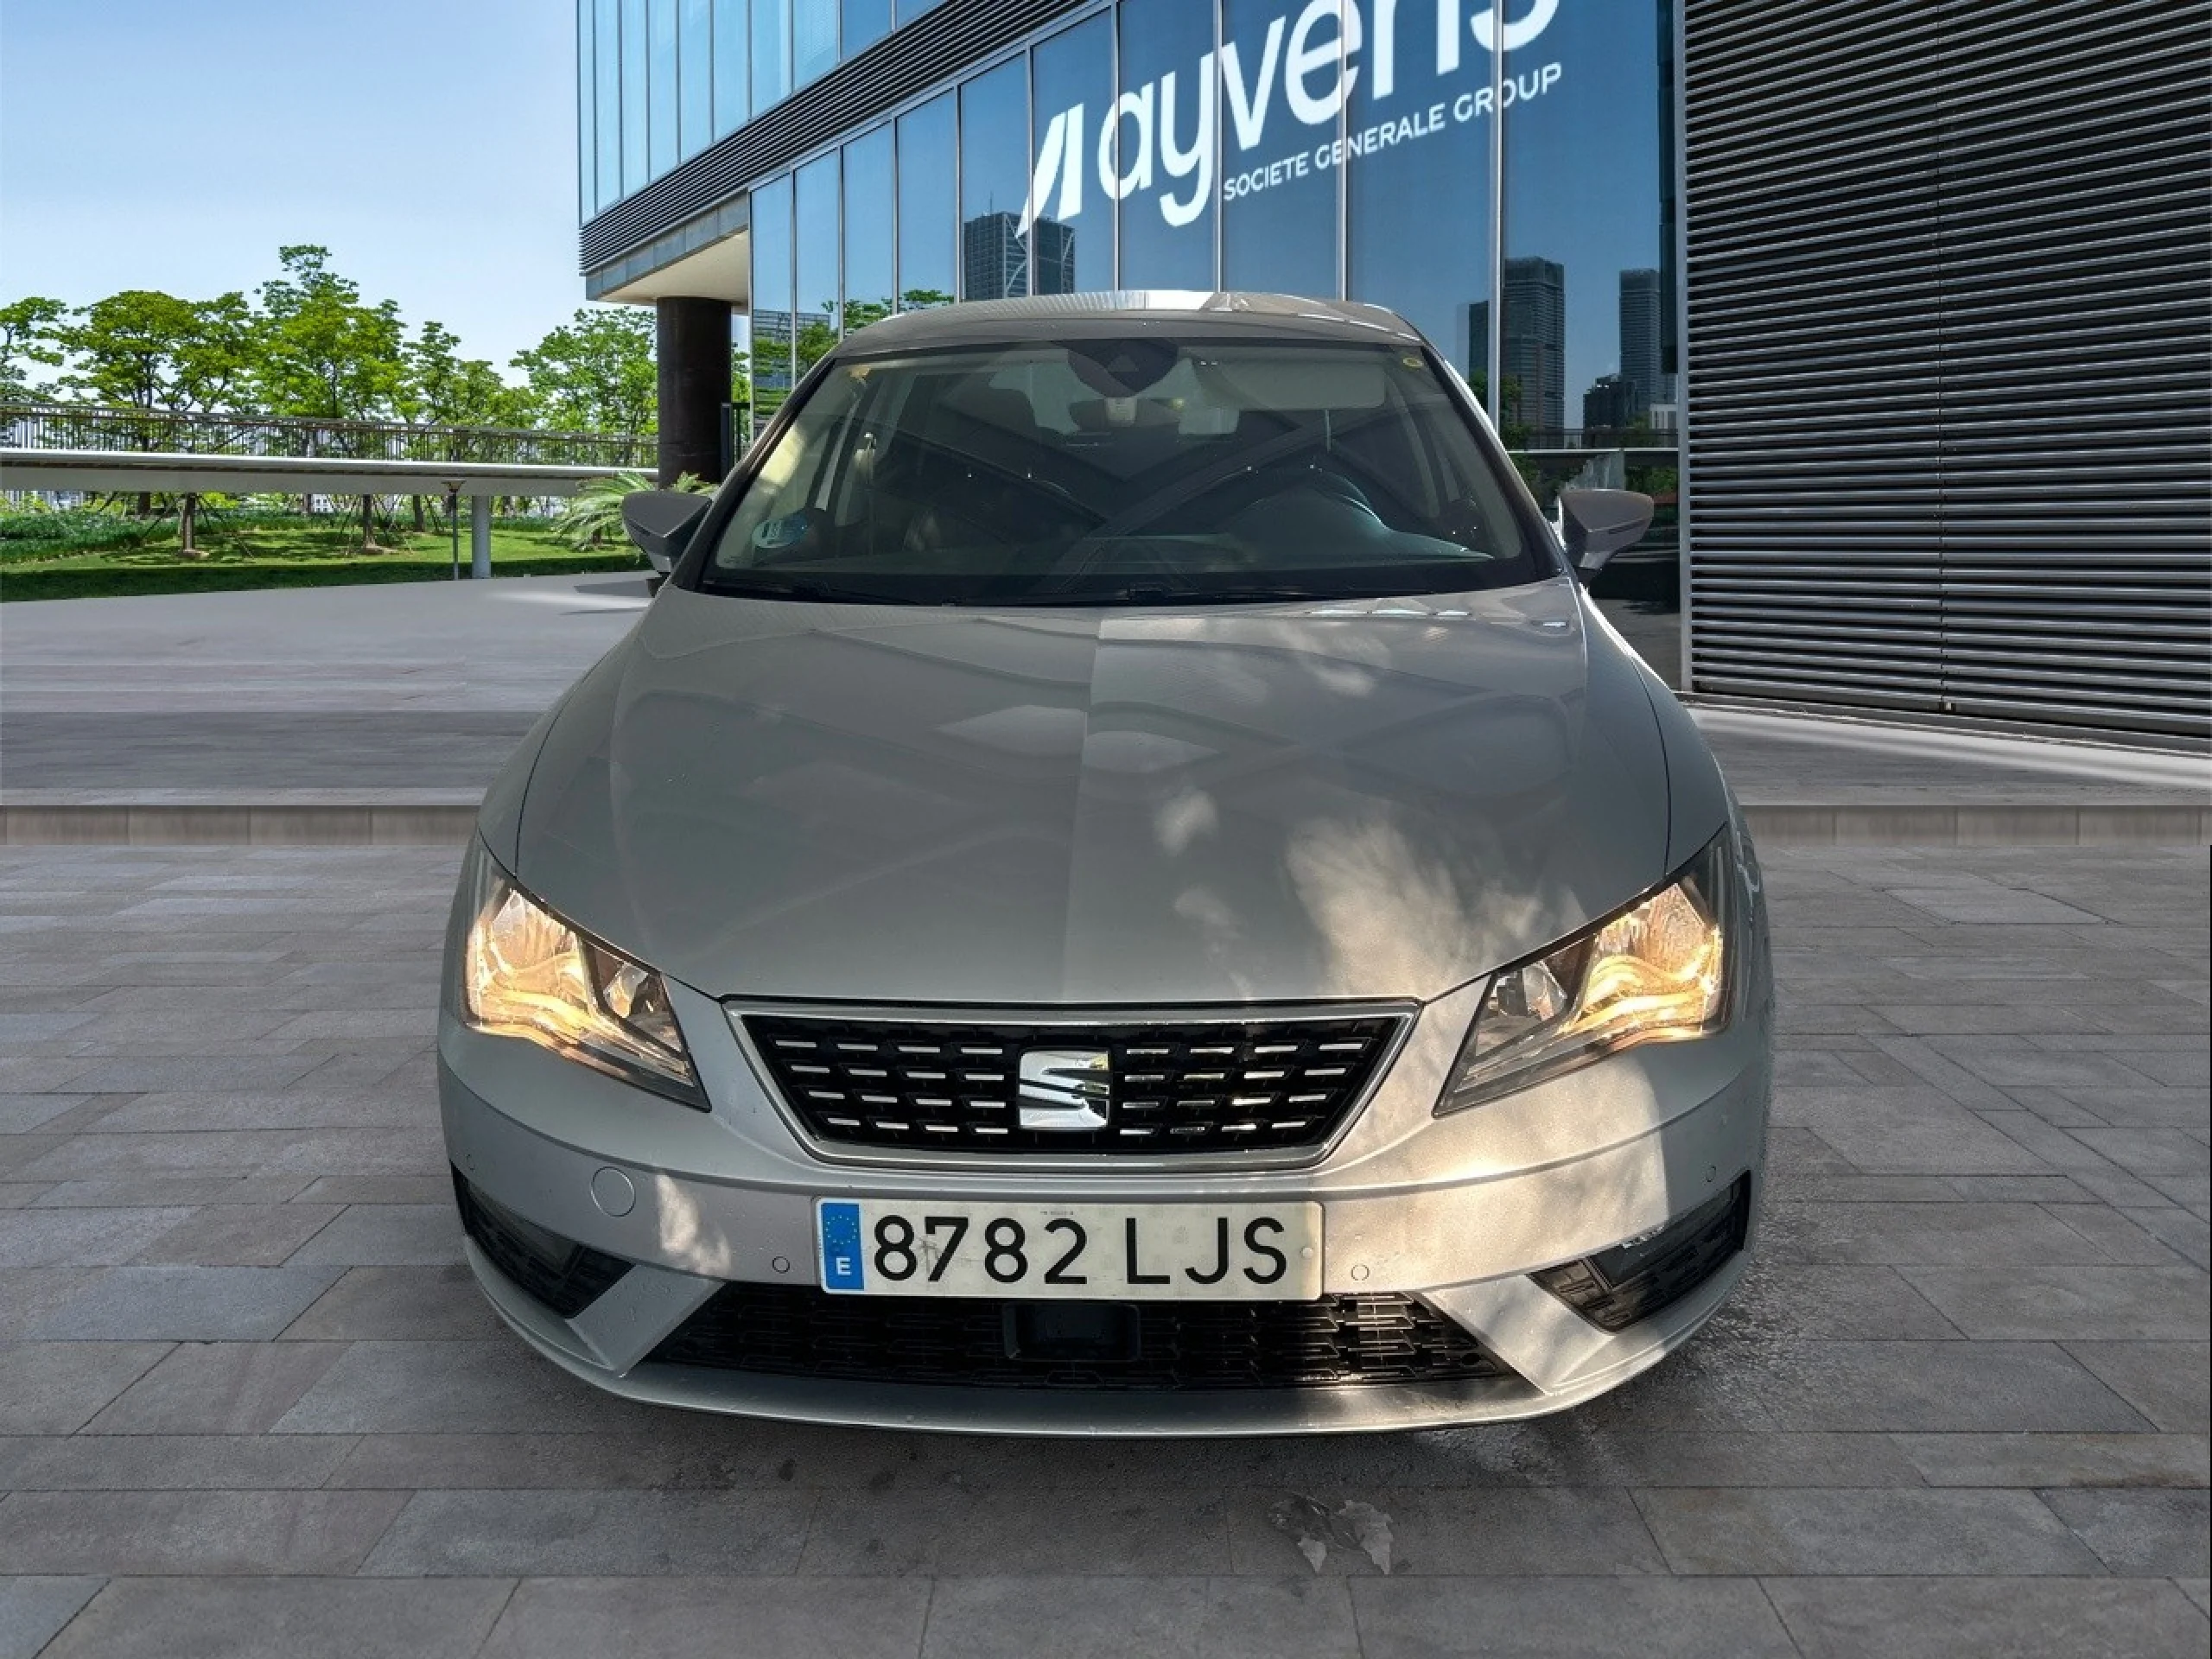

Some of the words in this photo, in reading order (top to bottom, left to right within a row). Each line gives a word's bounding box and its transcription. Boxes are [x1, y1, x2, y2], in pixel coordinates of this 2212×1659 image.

[1223, 151, 1310, 201] SOCIETE
[1314, 103, 1446, 170] GENERALE
[1452, 61, 1562, 123] GROUP
[836, 1256, 852, 1276] E
[874, 1214, 1088, 1286] 8782
[1126, 1217, 1287, 1286] LJS
